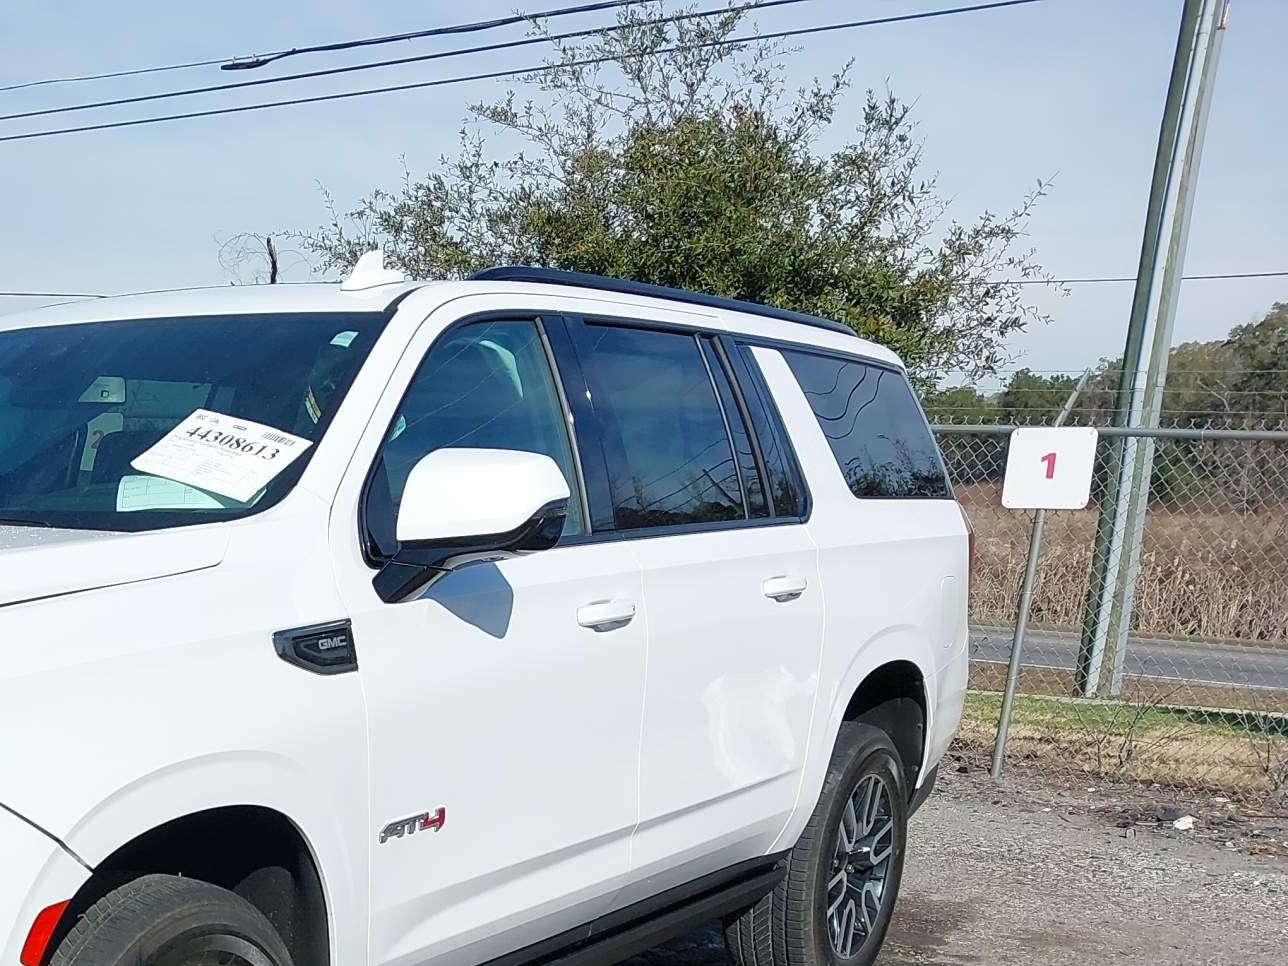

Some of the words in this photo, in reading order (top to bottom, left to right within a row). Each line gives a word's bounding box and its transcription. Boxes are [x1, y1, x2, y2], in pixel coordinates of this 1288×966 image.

[186, 426, 280, 460] 44308613
[1041, 453, 1057, 479] 1
[318, 635, 347, 650] GMC
[379, 807, 445, 844] AT4
